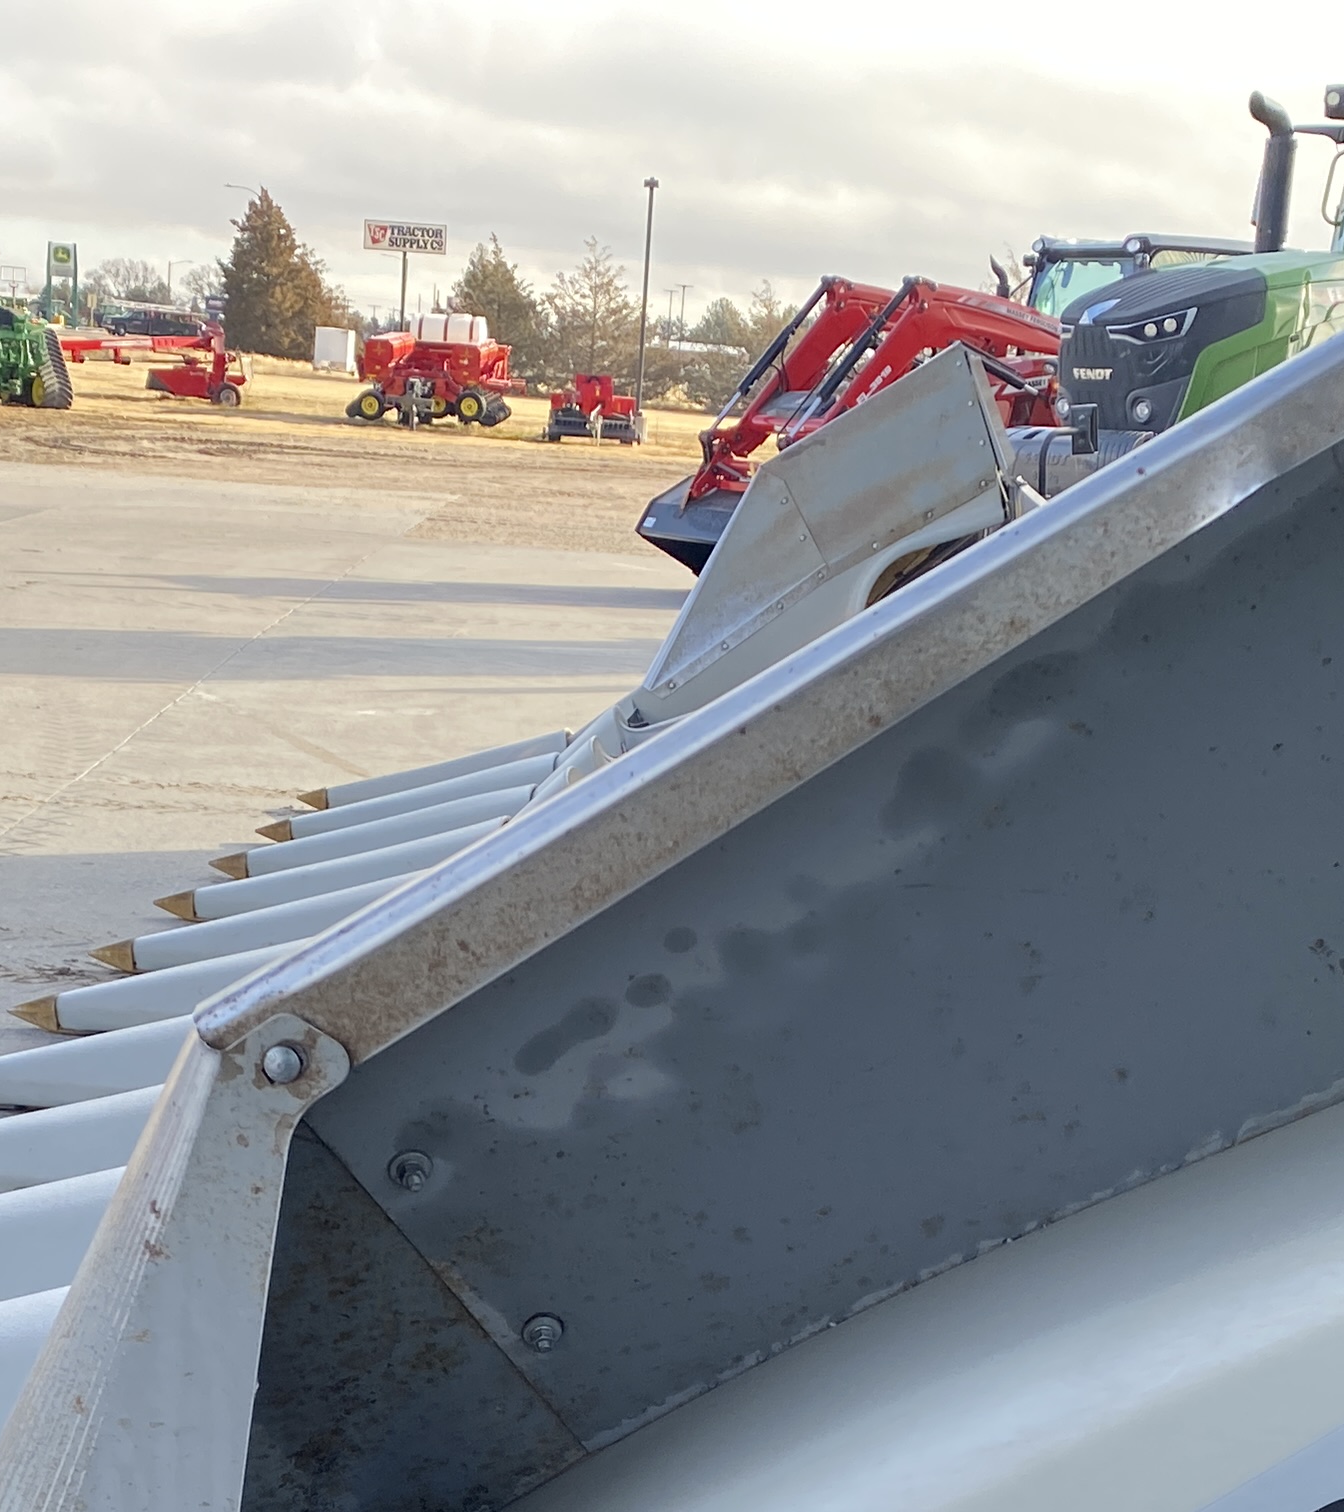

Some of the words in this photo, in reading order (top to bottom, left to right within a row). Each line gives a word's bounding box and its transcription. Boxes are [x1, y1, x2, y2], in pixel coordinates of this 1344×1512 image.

[388, 224, 443, 239] TRACTOR
[388, 236, 429, 250] SUPPLY
[1073, 367, 1113, 380] FENDT
